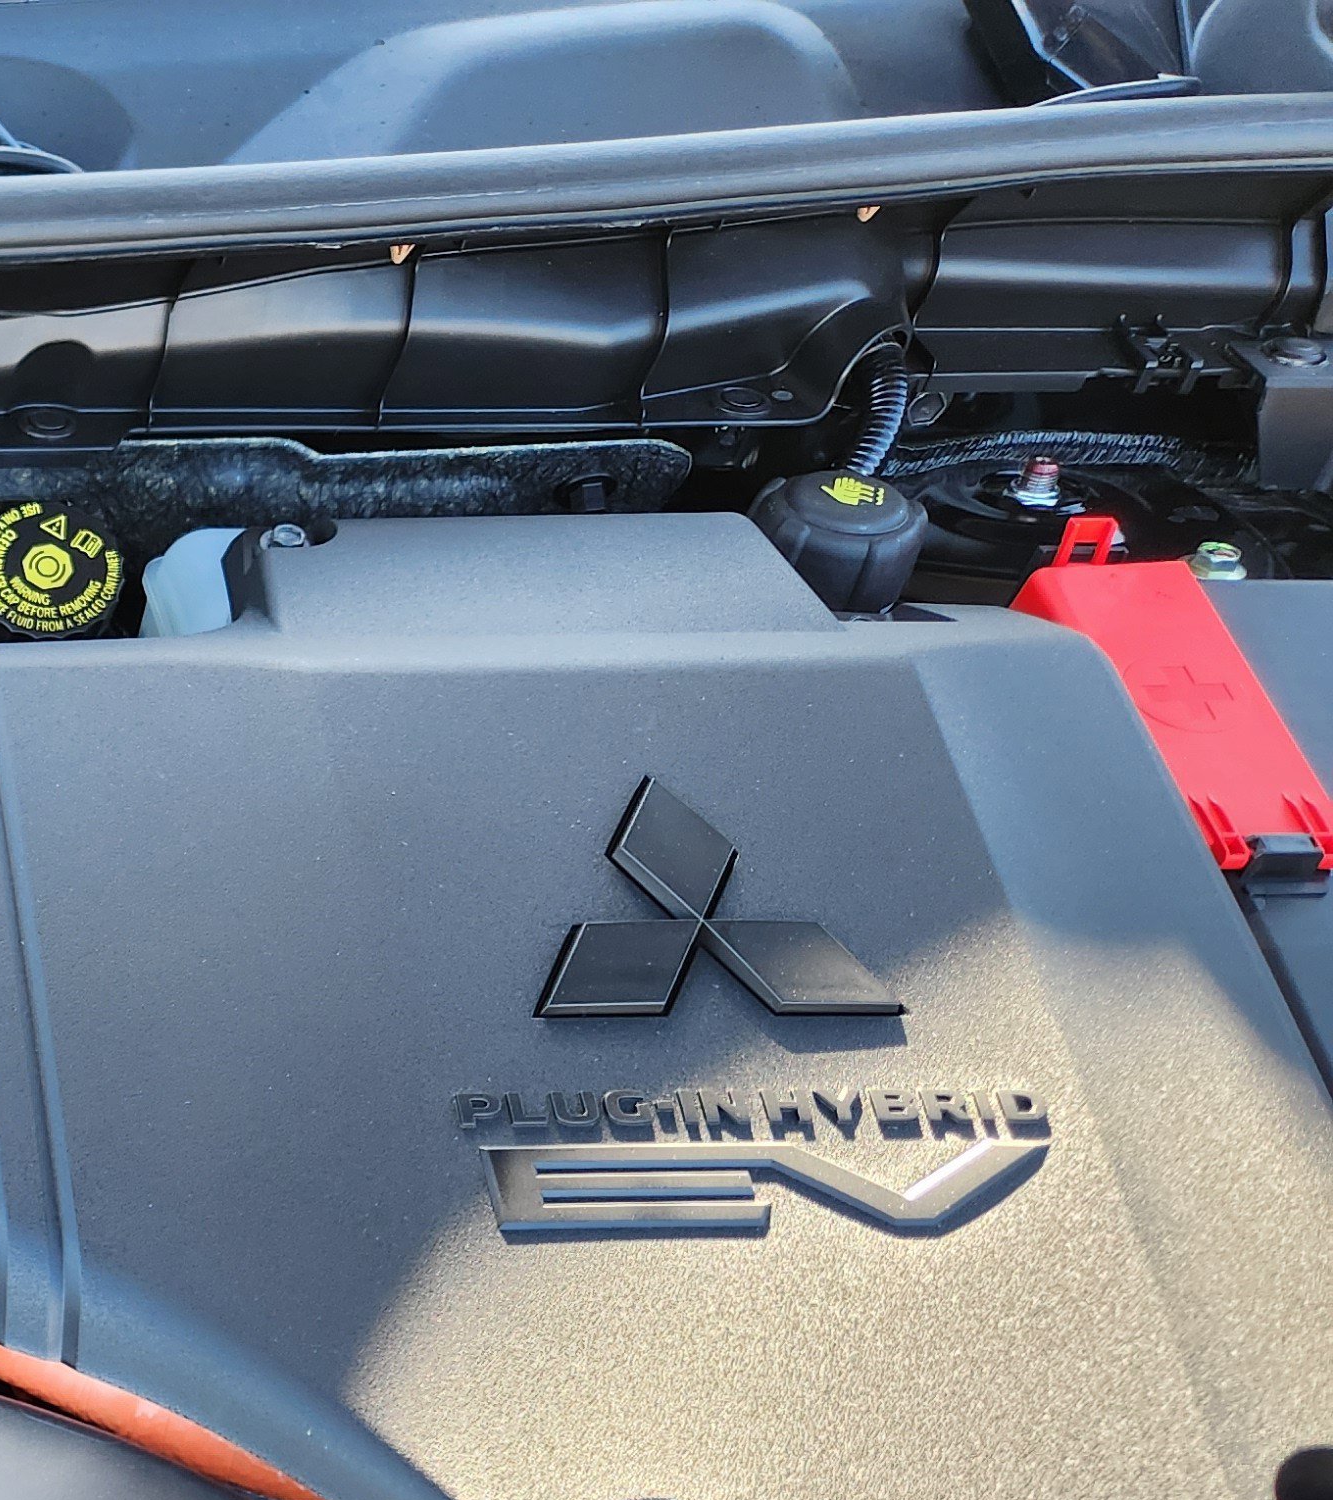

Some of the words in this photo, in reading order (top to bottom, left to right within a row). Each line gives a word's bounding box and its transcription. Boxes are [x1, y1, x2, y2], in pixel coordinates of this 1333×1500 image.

[20, 502, 43, 518] USE
[100, 549, 121, 601] CONTAINER
[0, 587, 20, 606] CAP
[17, 601, 58, 619] BEFORE
[59, 580, 102, 616] REMOVING
[9, 576, 51, 606] WARNING
[6, 611, 34, 630] FLUID
[35, 620, 65, 632] FROM
[66, 618, 74, 629] A
[73, 599, 106, 627] SEALED
[758, 1088, 1049, 1124] HYBRID
[479, 1142, 1051, 1232] EV
